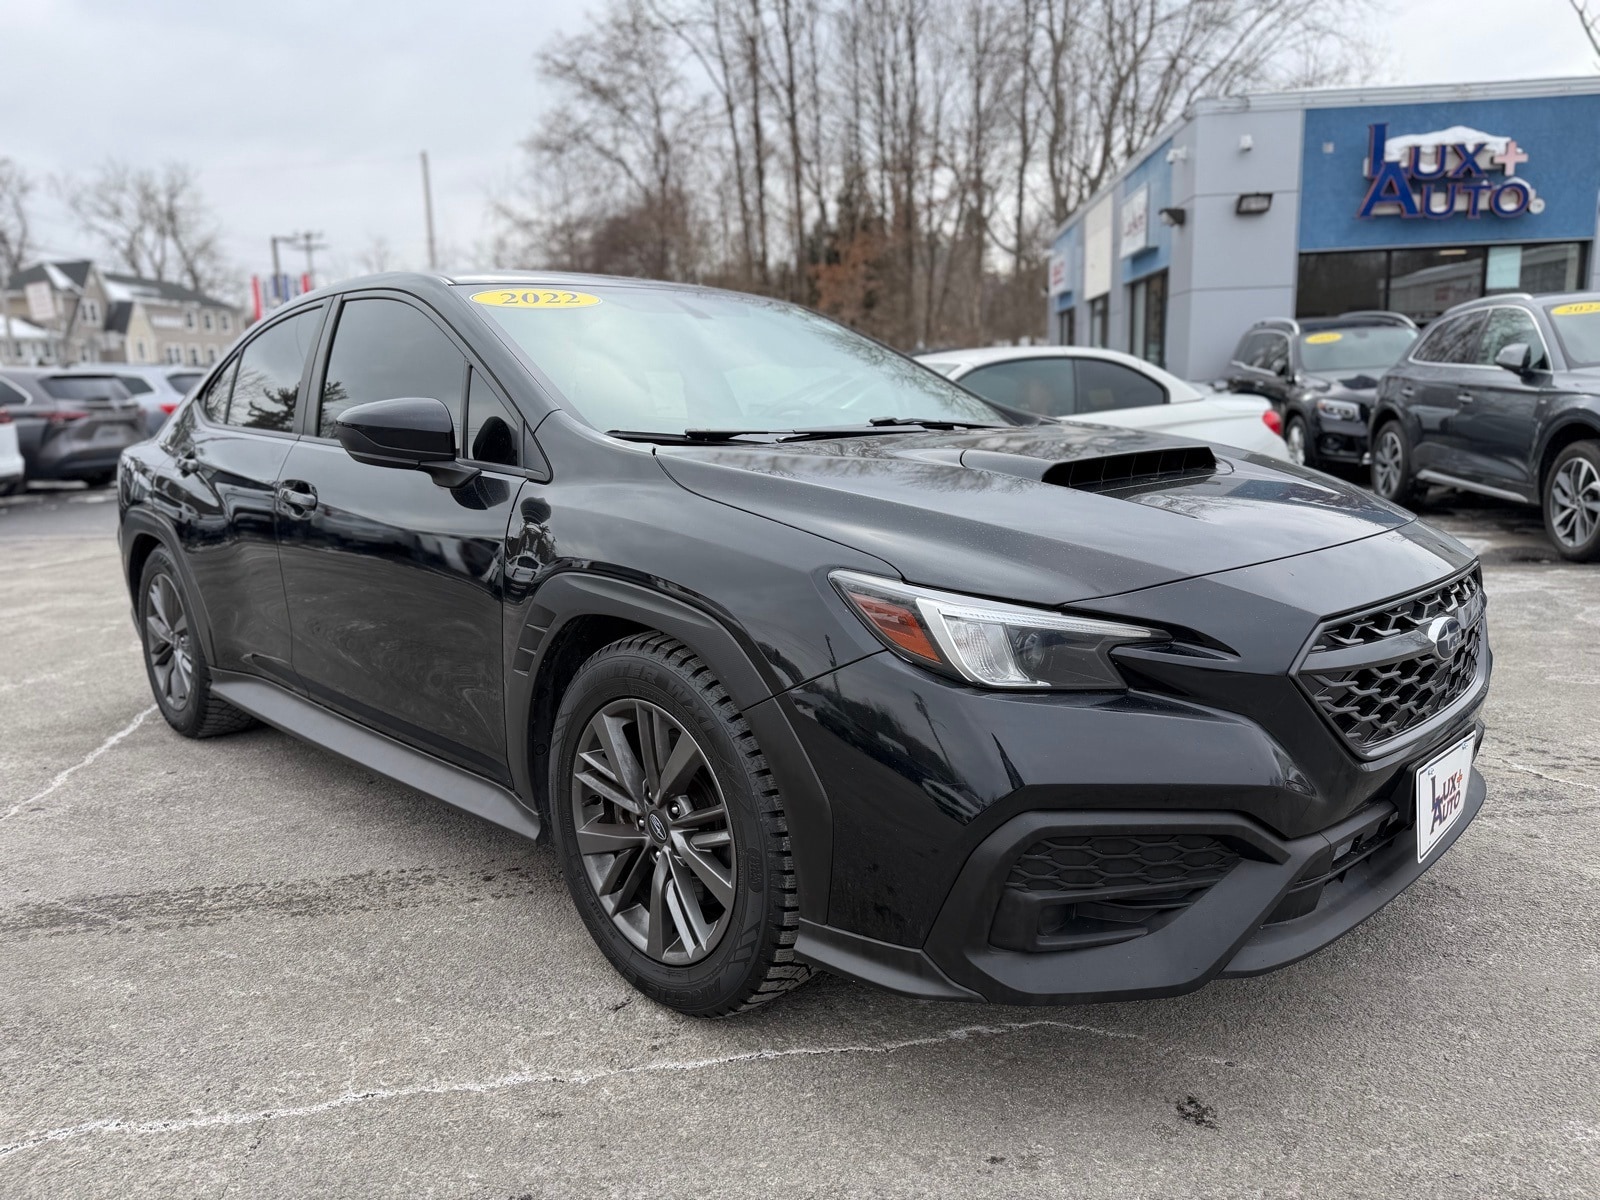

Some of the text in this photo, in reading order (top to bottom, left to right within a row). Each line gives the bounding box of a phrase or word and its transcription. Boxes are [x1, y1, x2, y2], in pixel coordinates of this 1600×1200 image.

[1357, 161, 1530, 218] AUTO
[500, 292, 580, 304] 2022
[1430, 789, 1461, 835] AUTO
